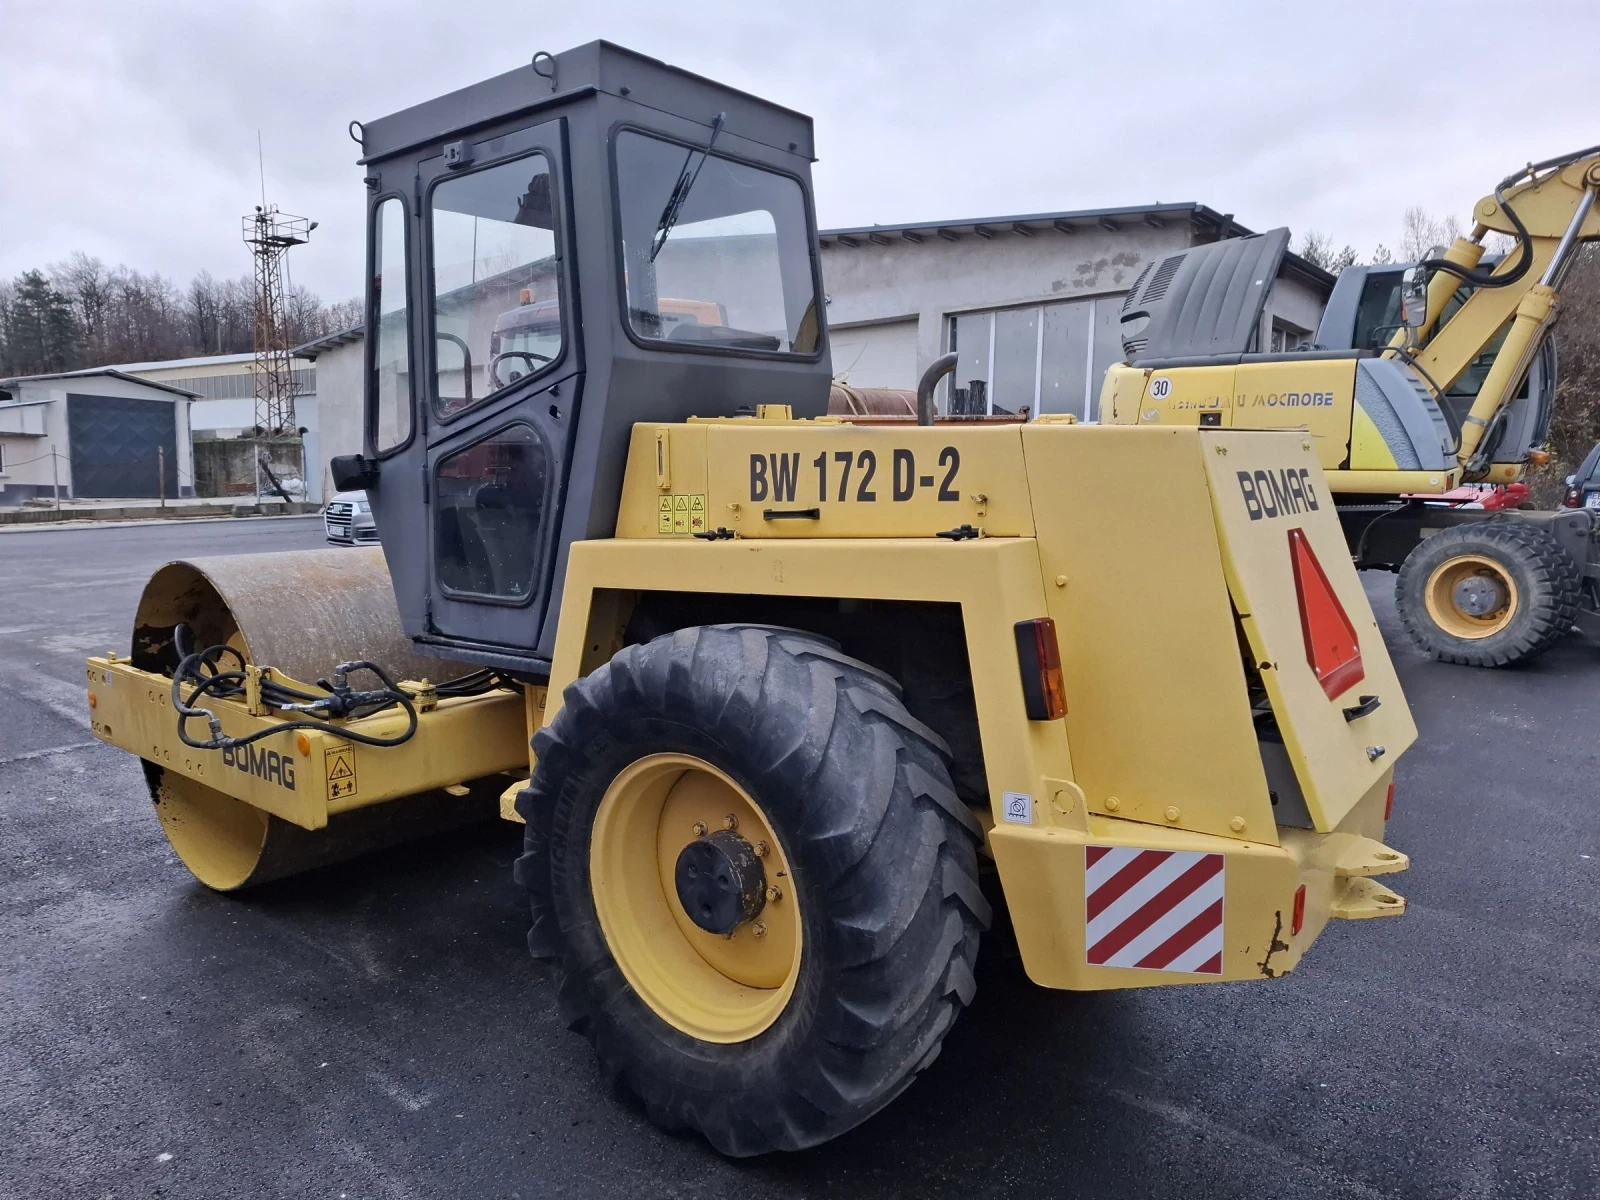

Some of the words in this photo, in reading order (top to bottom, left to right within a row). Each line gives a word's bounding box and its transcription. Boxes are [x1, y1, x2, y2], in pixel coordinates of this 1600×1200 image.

[1153, 380, 1169, 396] 30
[749, 452, 800, 502] BW
[813, 450, 877, 502] 172
[893, 446, 960, 502] D-2
[1236, 468, 1320, 520] BOMAG
[222, 743, 296, 791] BOMAG
